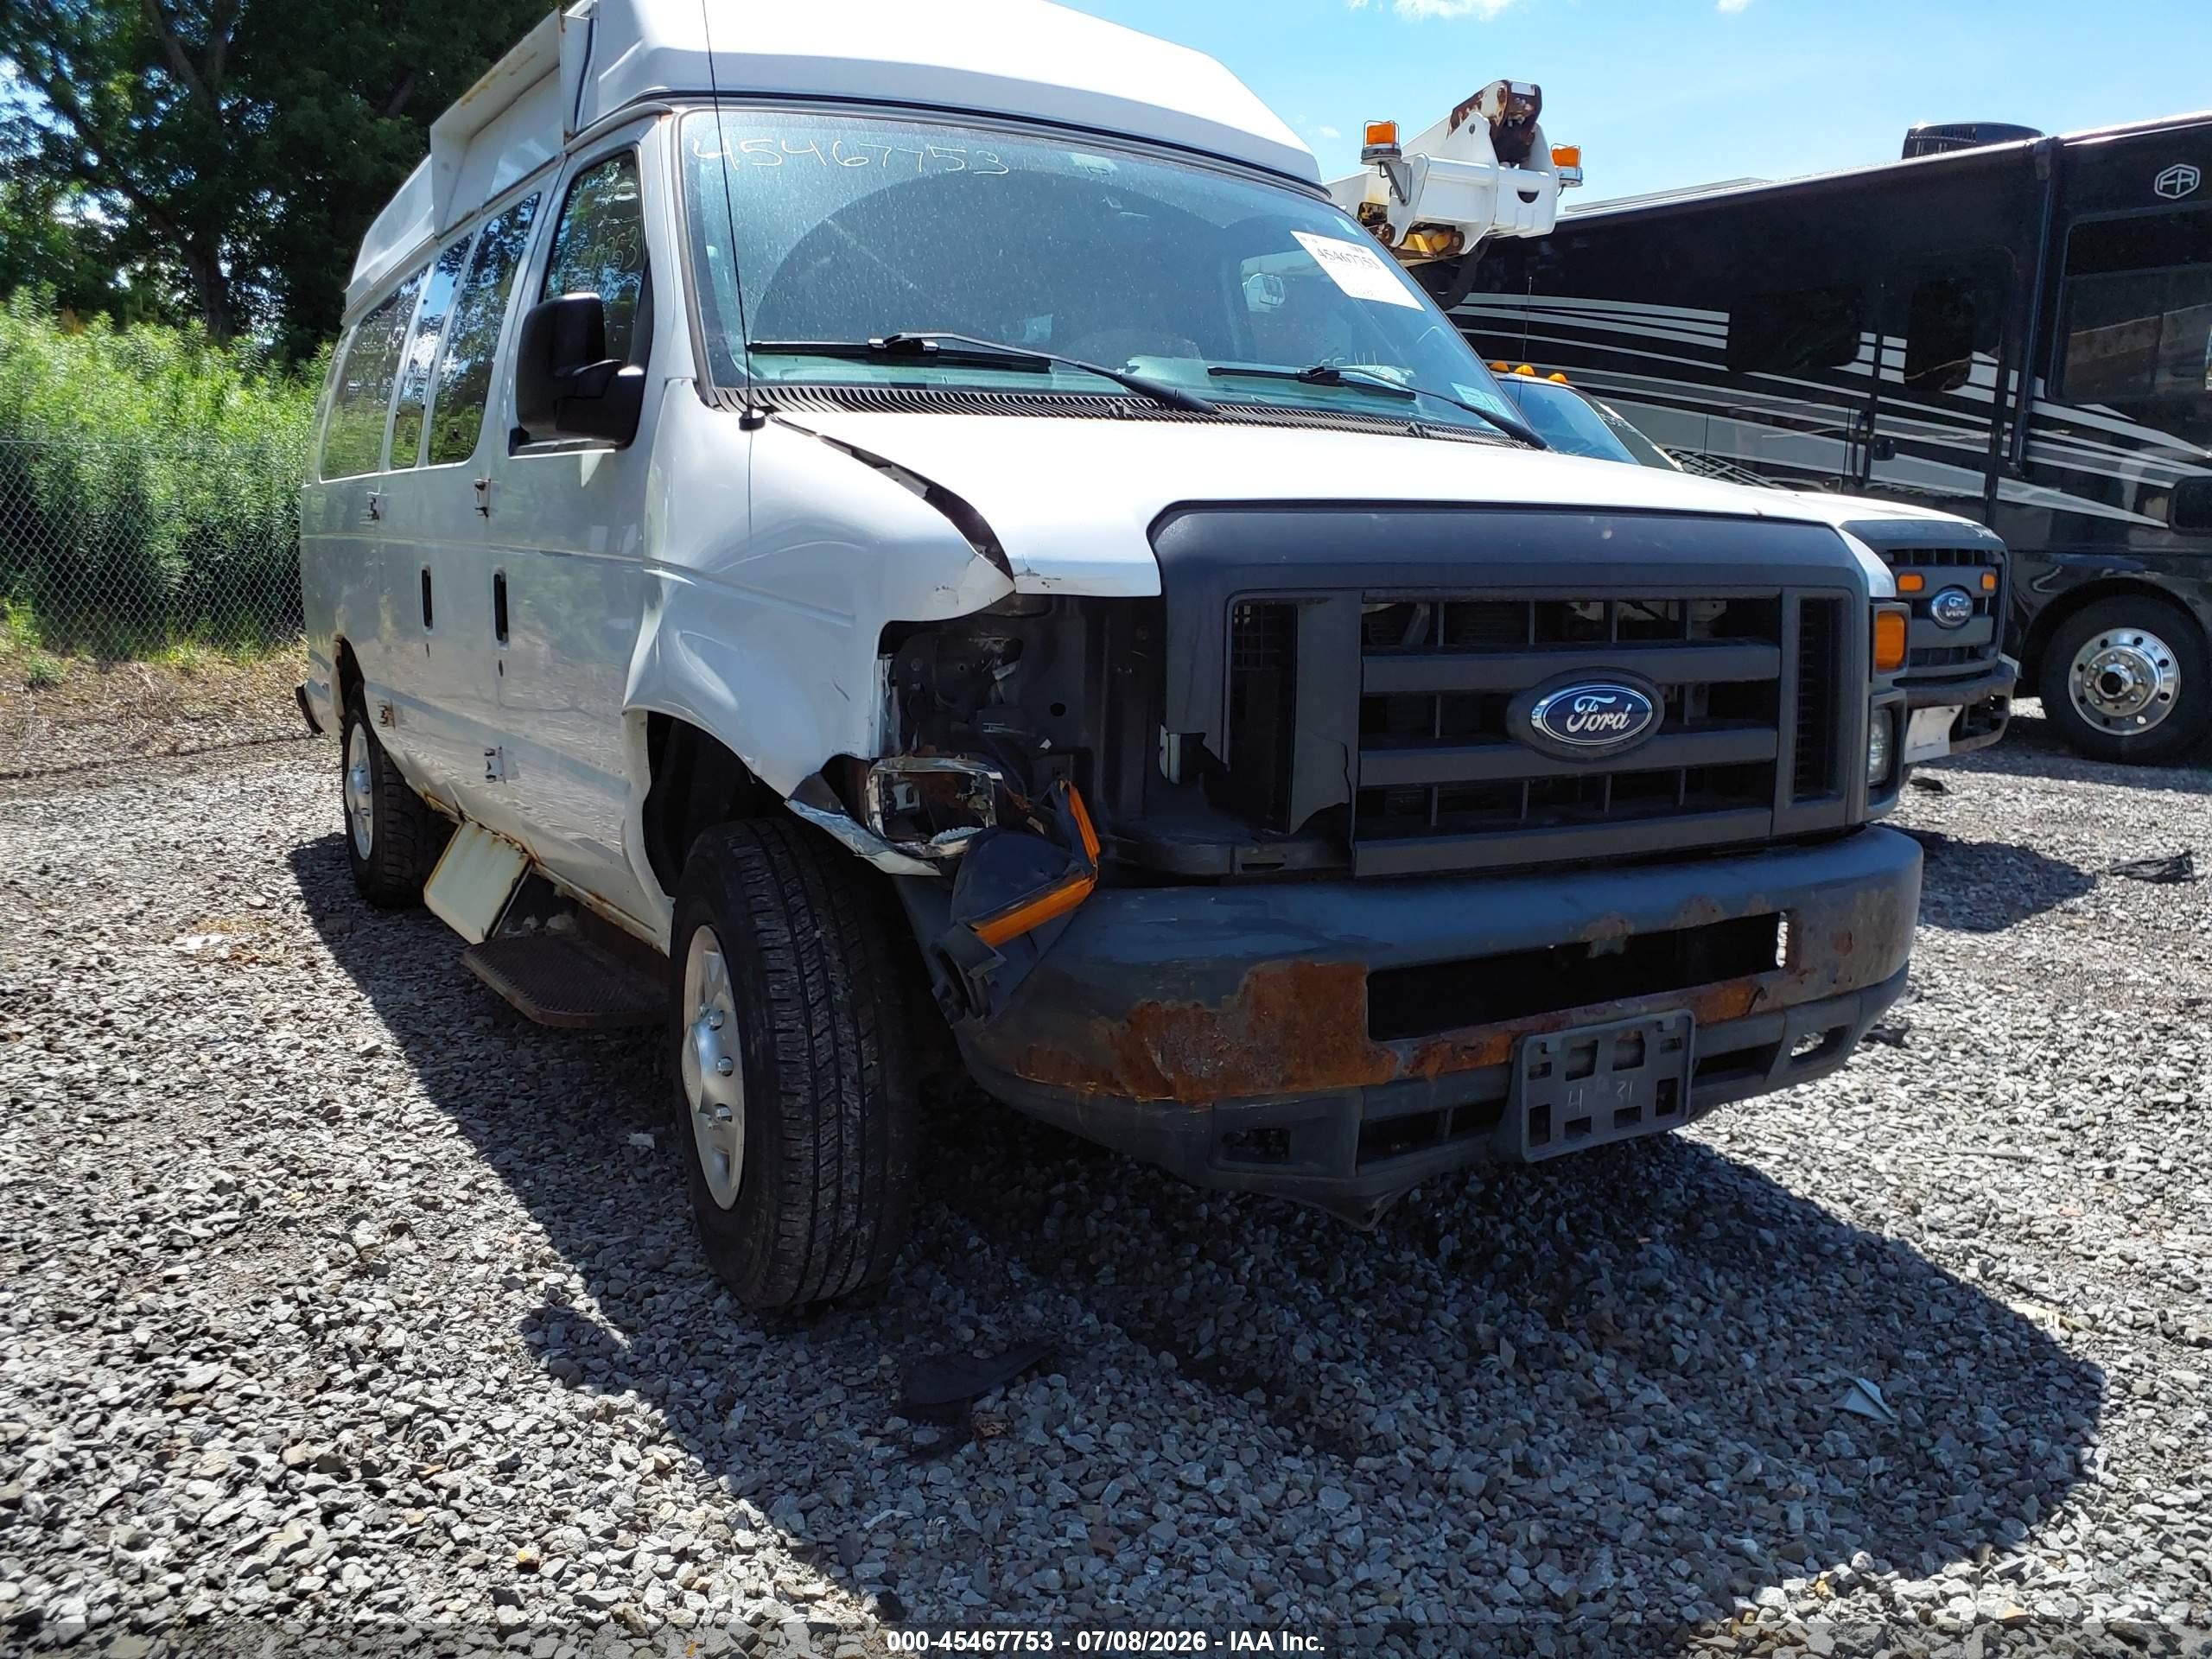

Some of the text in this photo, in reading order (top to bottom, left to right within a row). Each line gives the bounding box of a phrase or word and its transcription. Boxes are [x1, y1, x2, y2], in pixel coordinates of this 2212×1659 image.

[693, 137, 1010, 175] 45467753
[1316, 247, 1381, 270] 45467753
[1566, 695, 1632, 733] Ford
